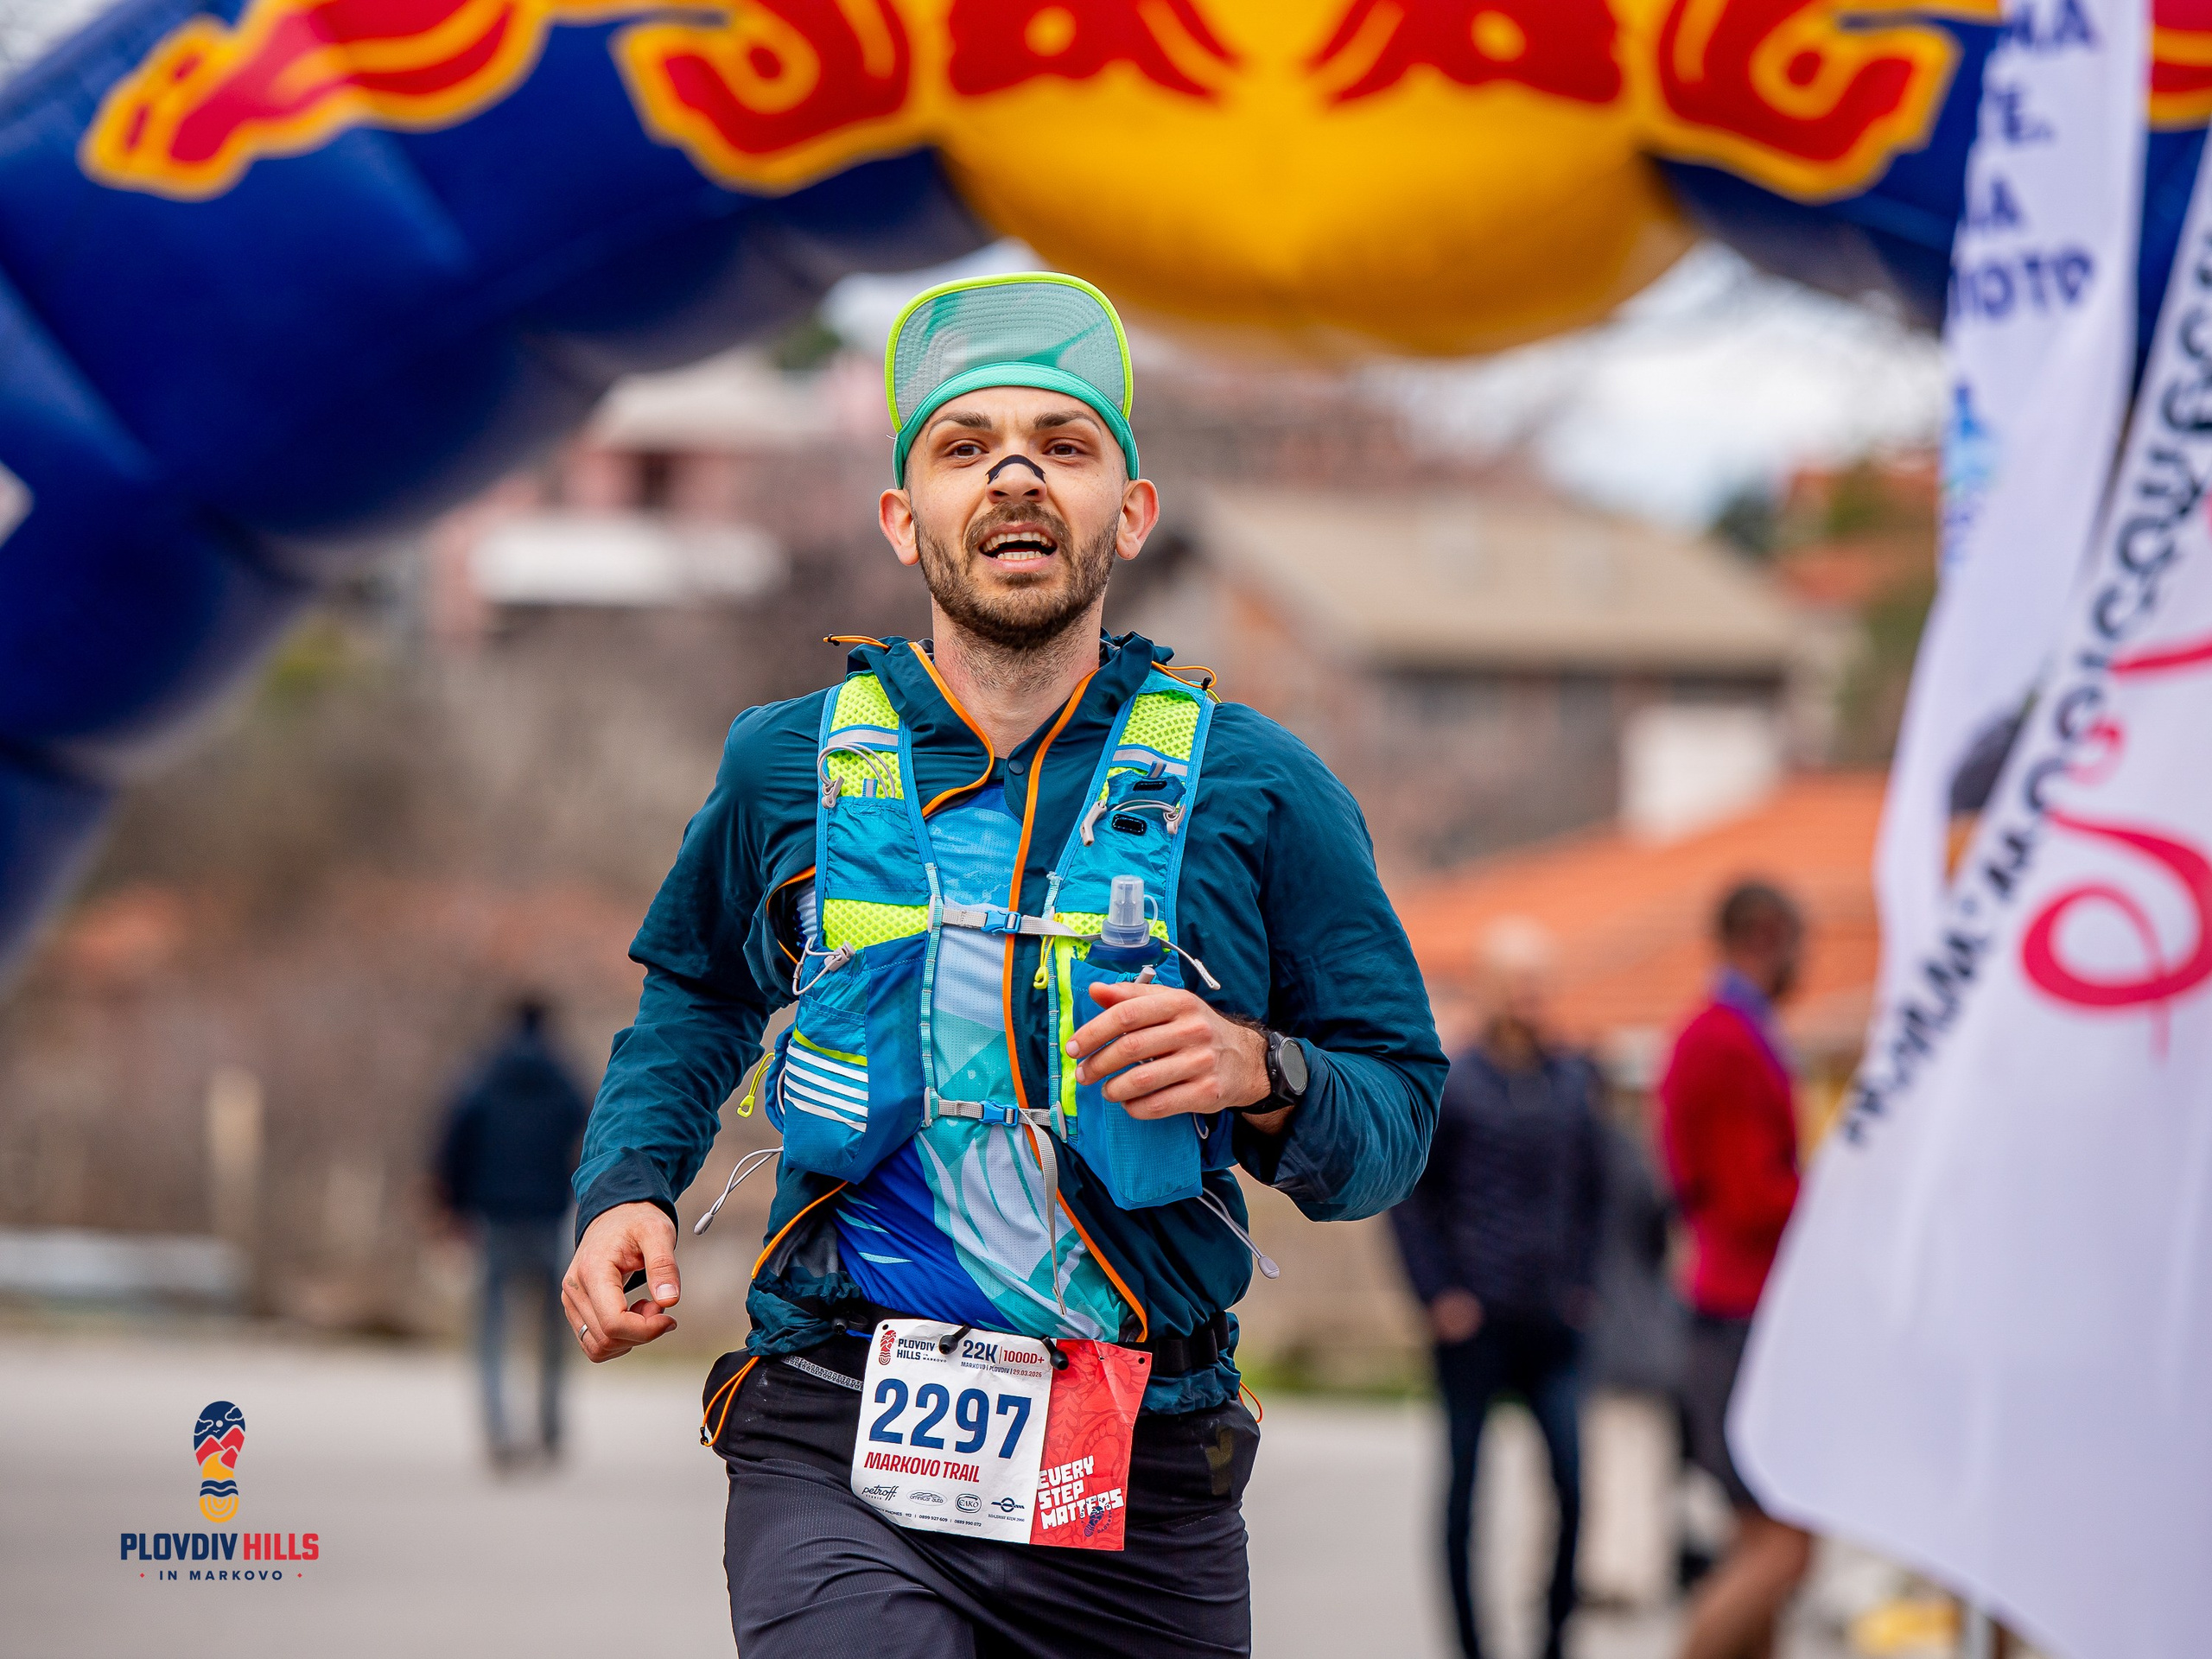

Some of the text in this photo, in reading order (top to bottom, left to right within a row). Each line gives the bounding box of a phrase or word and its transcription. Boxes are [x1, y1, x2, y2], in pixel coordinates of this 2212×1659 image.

[896, 1349, 921, 1360] HILLS
[898, 1338, 936, 1351] PLOVDIV
[962, 1339, 1045, 1364] 22K 1000D+
[961, 1361, 986, 1370] MARKOVO
[988, 1365, 1010, 1374] PLOVDIV
[868, 1377, 1032, 1460] 2297
[864, 1452, 980, 1484] MARKOVO TRAIL
[1037, 1455, 1094, 1490] EVERY
[1038, 1479, 1084, 1510] STEP
[1040, 1488, 1124, 1530] MATTERS
